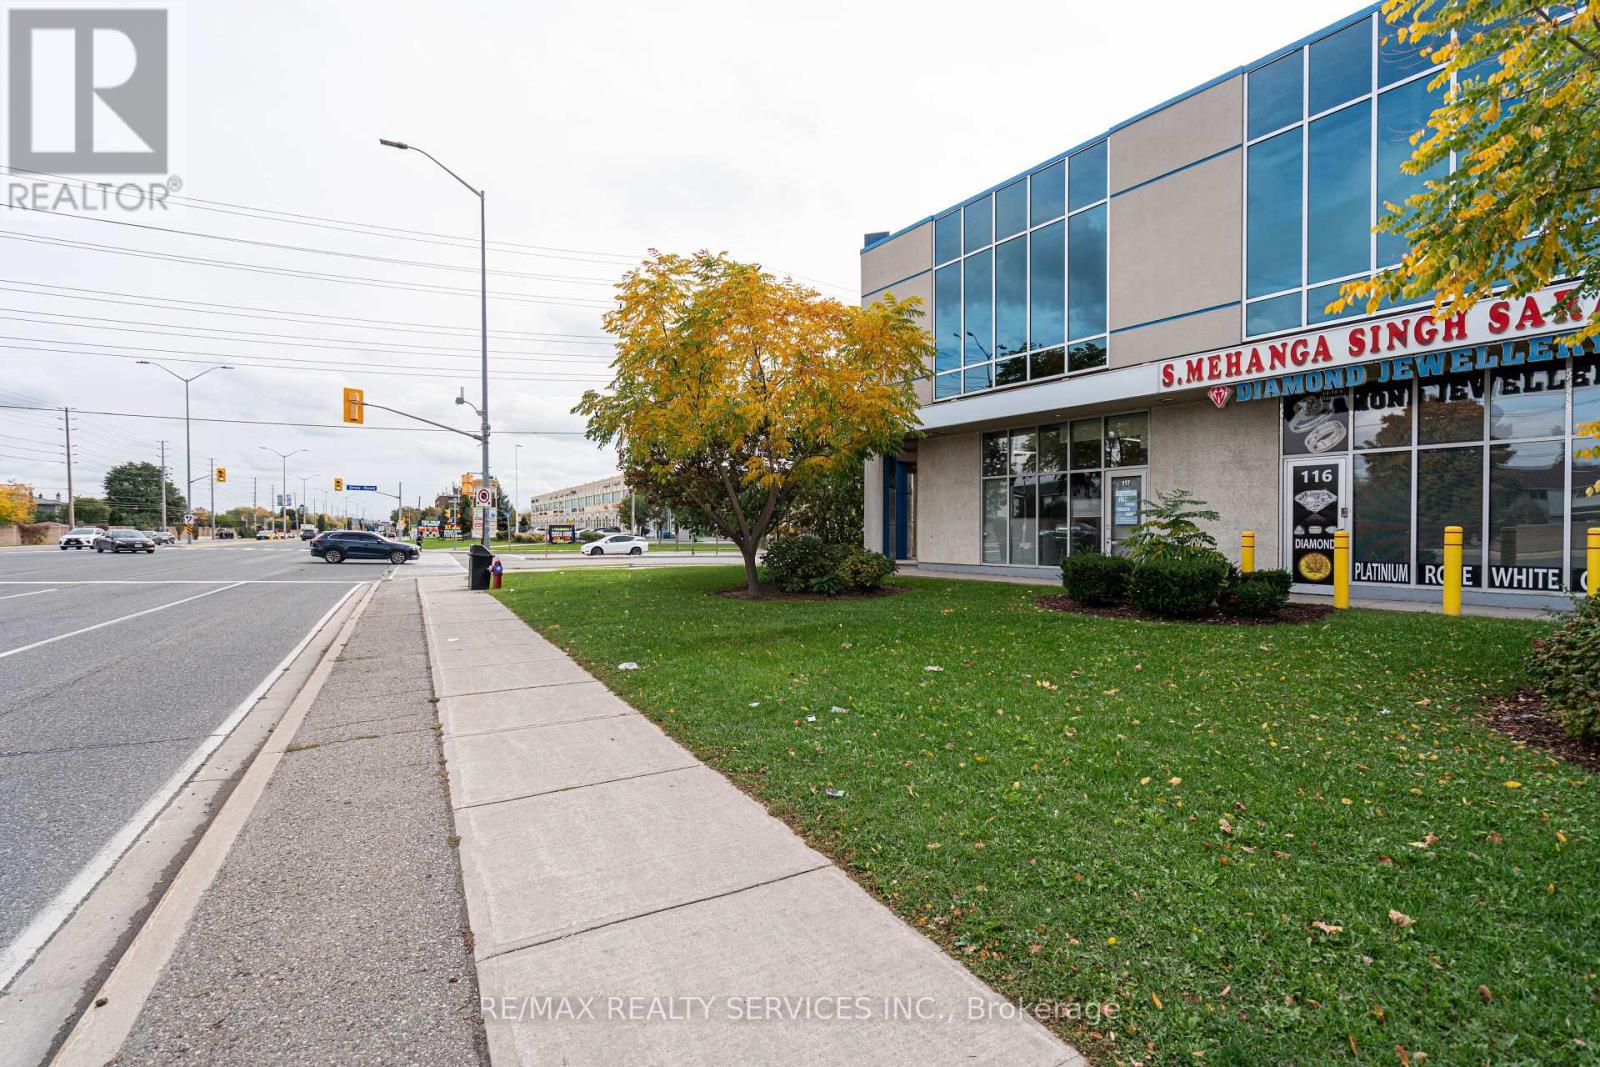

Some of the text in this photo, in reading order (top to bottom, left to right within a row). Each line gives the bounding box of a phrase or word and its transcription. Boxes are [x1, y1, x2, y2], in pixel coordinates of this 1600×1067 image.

[1162, 334, 1333, 388] S.MEHANGA
[1348, 308, 1468, 357] SINGH
[1236, 365, 1368, 402] DIAMOND
[1301, 469, 1333, 483] 116
[1355, 562, 1408, 582] PLATINIUM
[1491, 567, 1559, 589] WHITE
